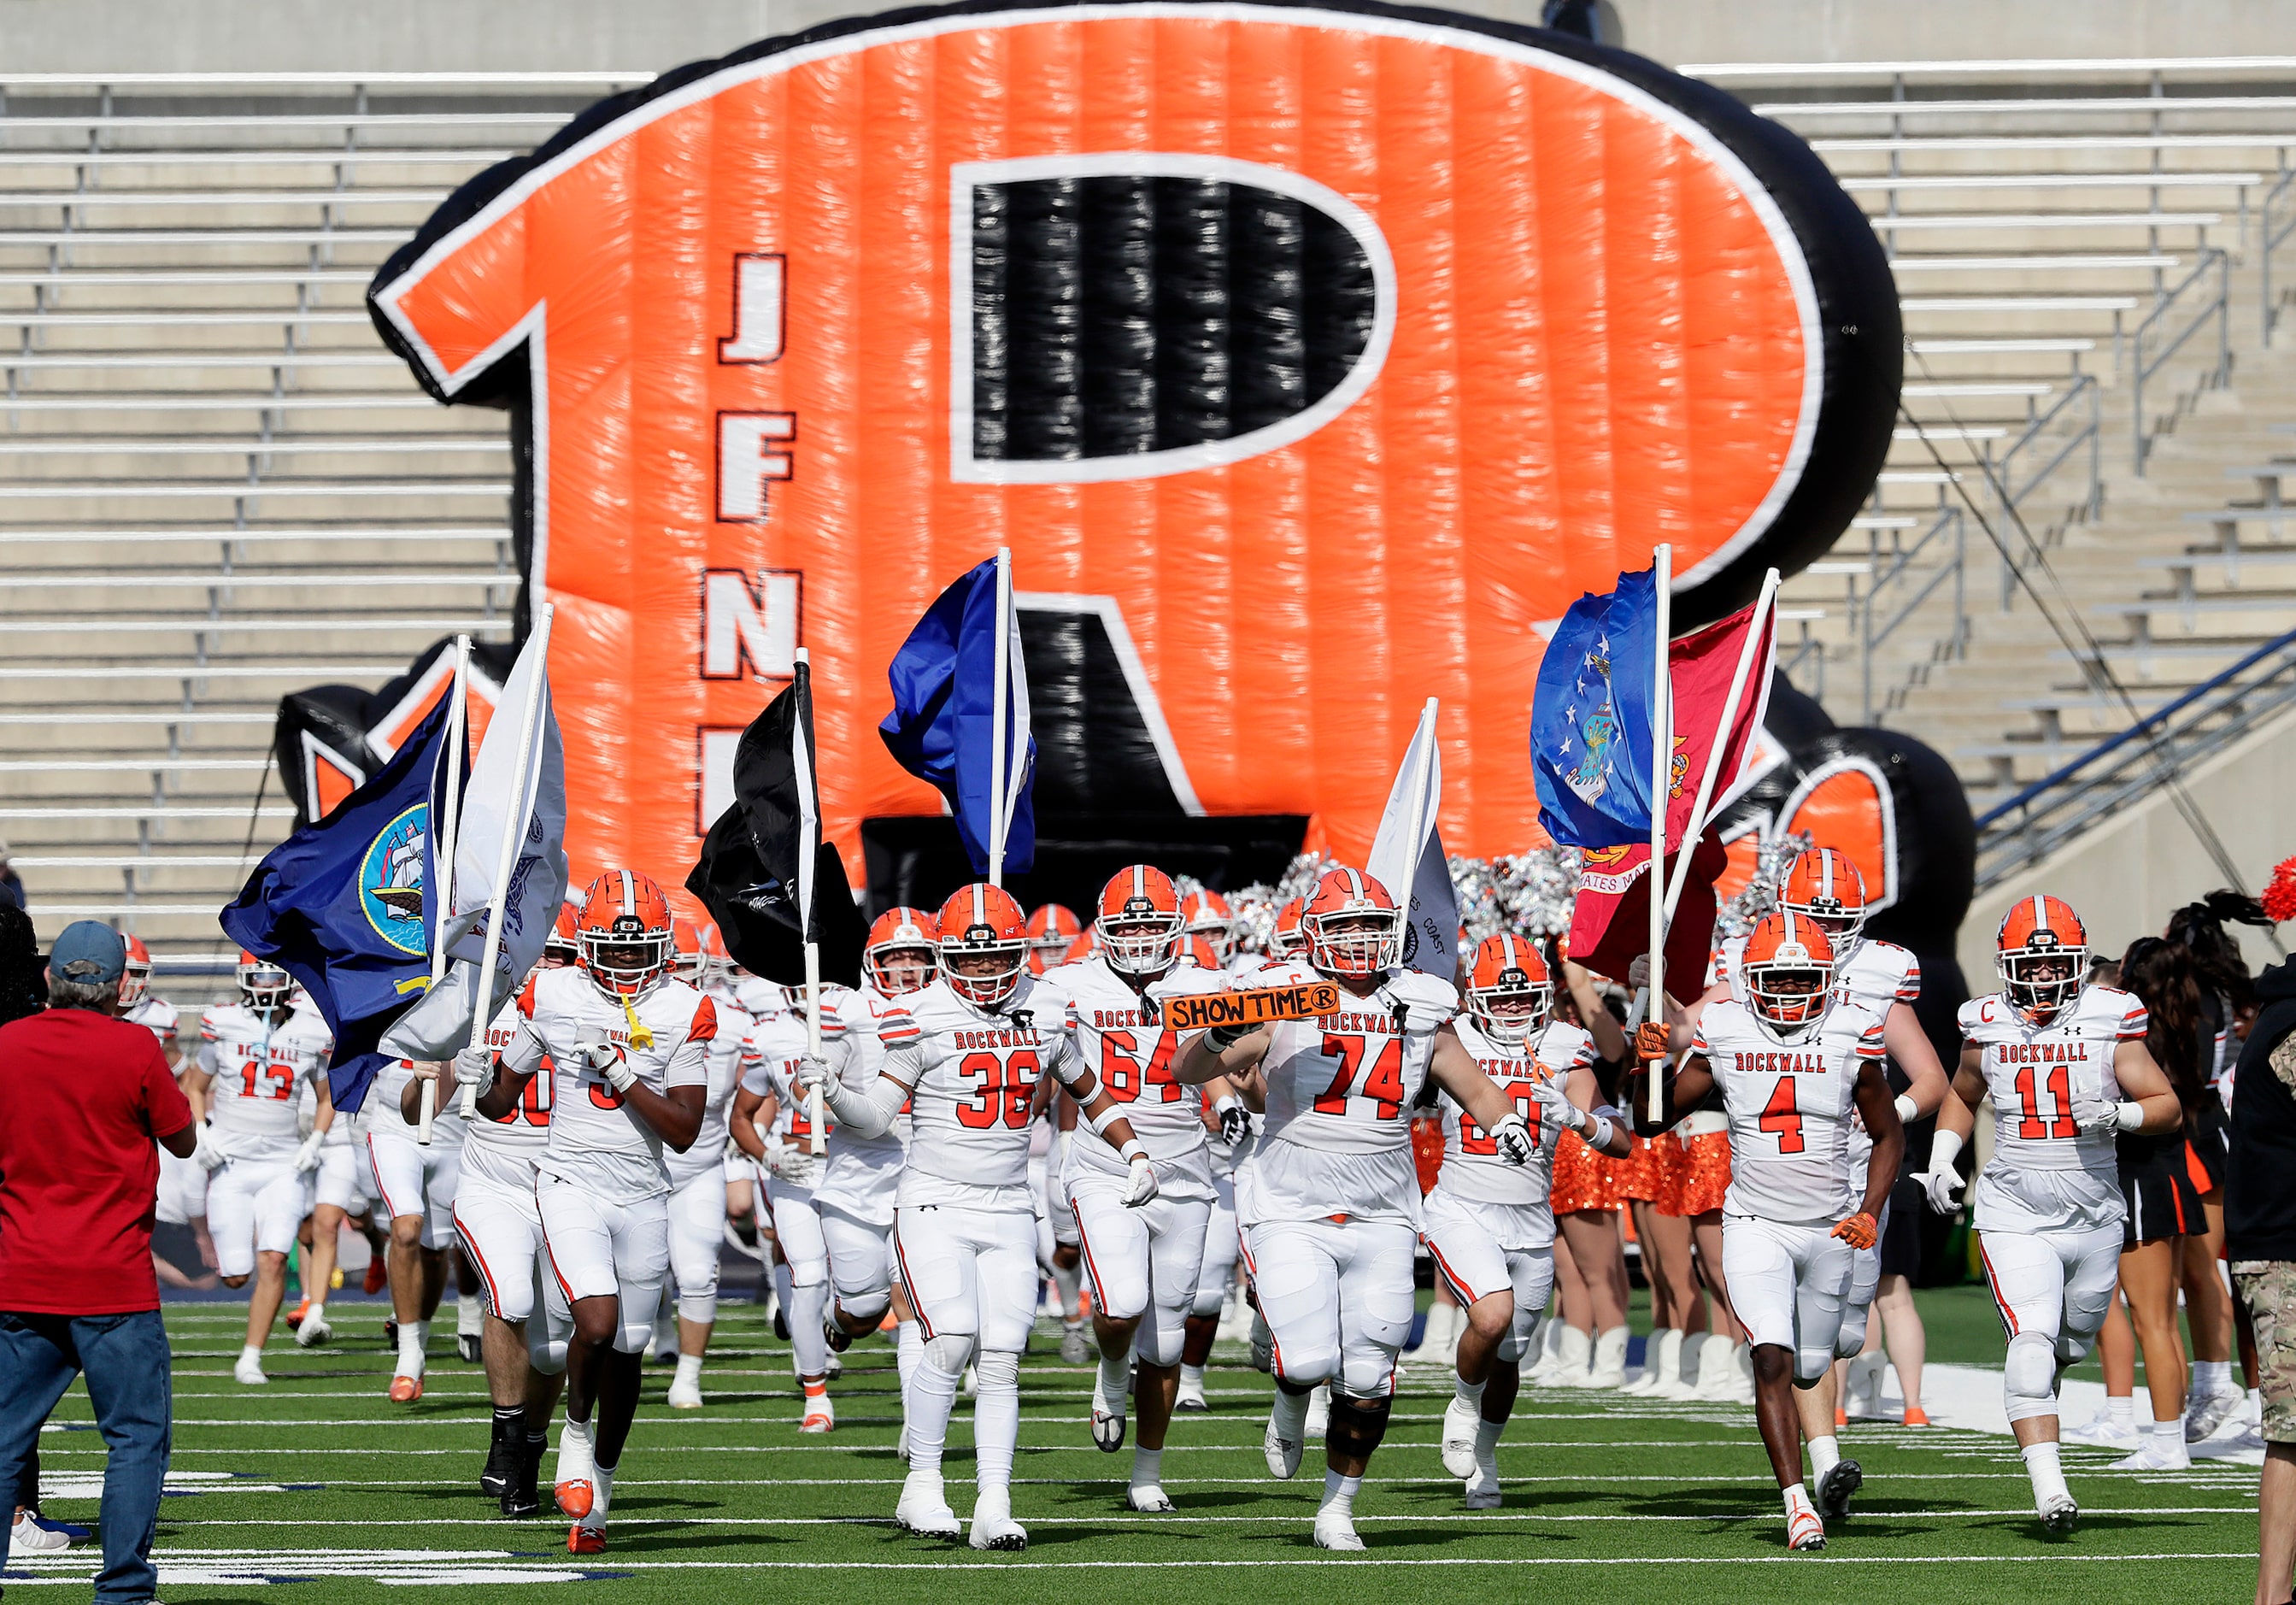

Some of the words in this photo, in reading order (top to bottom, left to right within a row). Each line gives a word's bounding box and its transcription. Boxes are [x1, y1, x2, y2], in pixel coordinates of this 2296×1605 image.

[696, 252, 803, 838] JFN
[1579, 875, 1618, 891] ATES
[1423, 916, 1446, 956] COAST
[868, 999, 882, 1018] C
[1981, 1000, 1995, 1023] C
[954, 1028, 1042, 1050] ROCKWALL
[1999, 1042, 2088, 1063] ROCKWALL
[238, 1061, 294, 1101] 13
[1101, 1030, 1183, 1103] 64
[1312, 1032, 1405, 1120] 74
[1735, 1052, 1827, 1073] ROCKWALL
[955, 1049, 1041, 1130] 36
[2014, 1065, 2082, 1140] 11
[1759, 1075, 1806, 1155] 4
